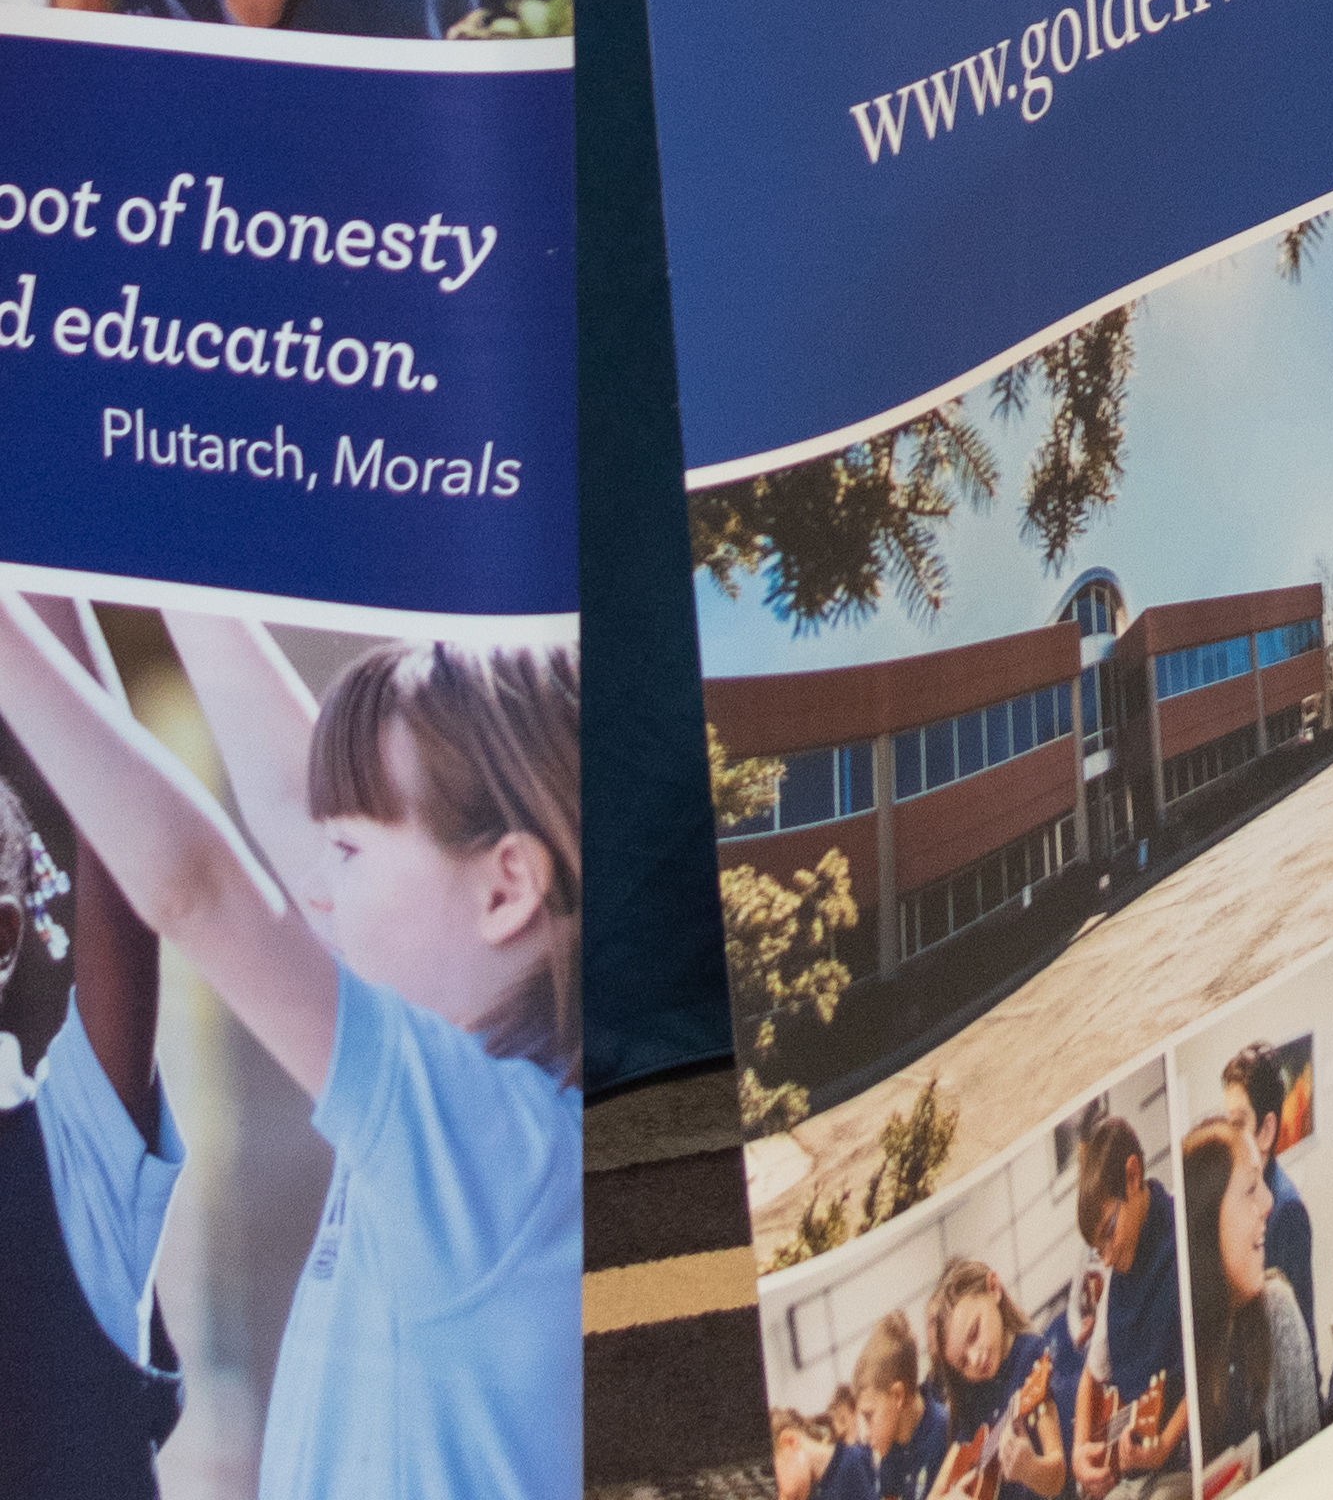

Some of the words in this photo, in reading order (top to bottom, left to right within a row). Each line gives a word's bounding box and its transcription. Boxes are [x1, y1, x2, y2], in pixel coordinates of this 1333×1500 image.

[0, 179, 102, 239] oot
[116, 172, 196, 247] of
[200, 175, 498, 292] honesty
[0, 273, 37, 349] d
[52, 284, 439, 392] education.
[101, 406, 319, 492] Plutarch,
[331, 434, 523, 497] Morals
